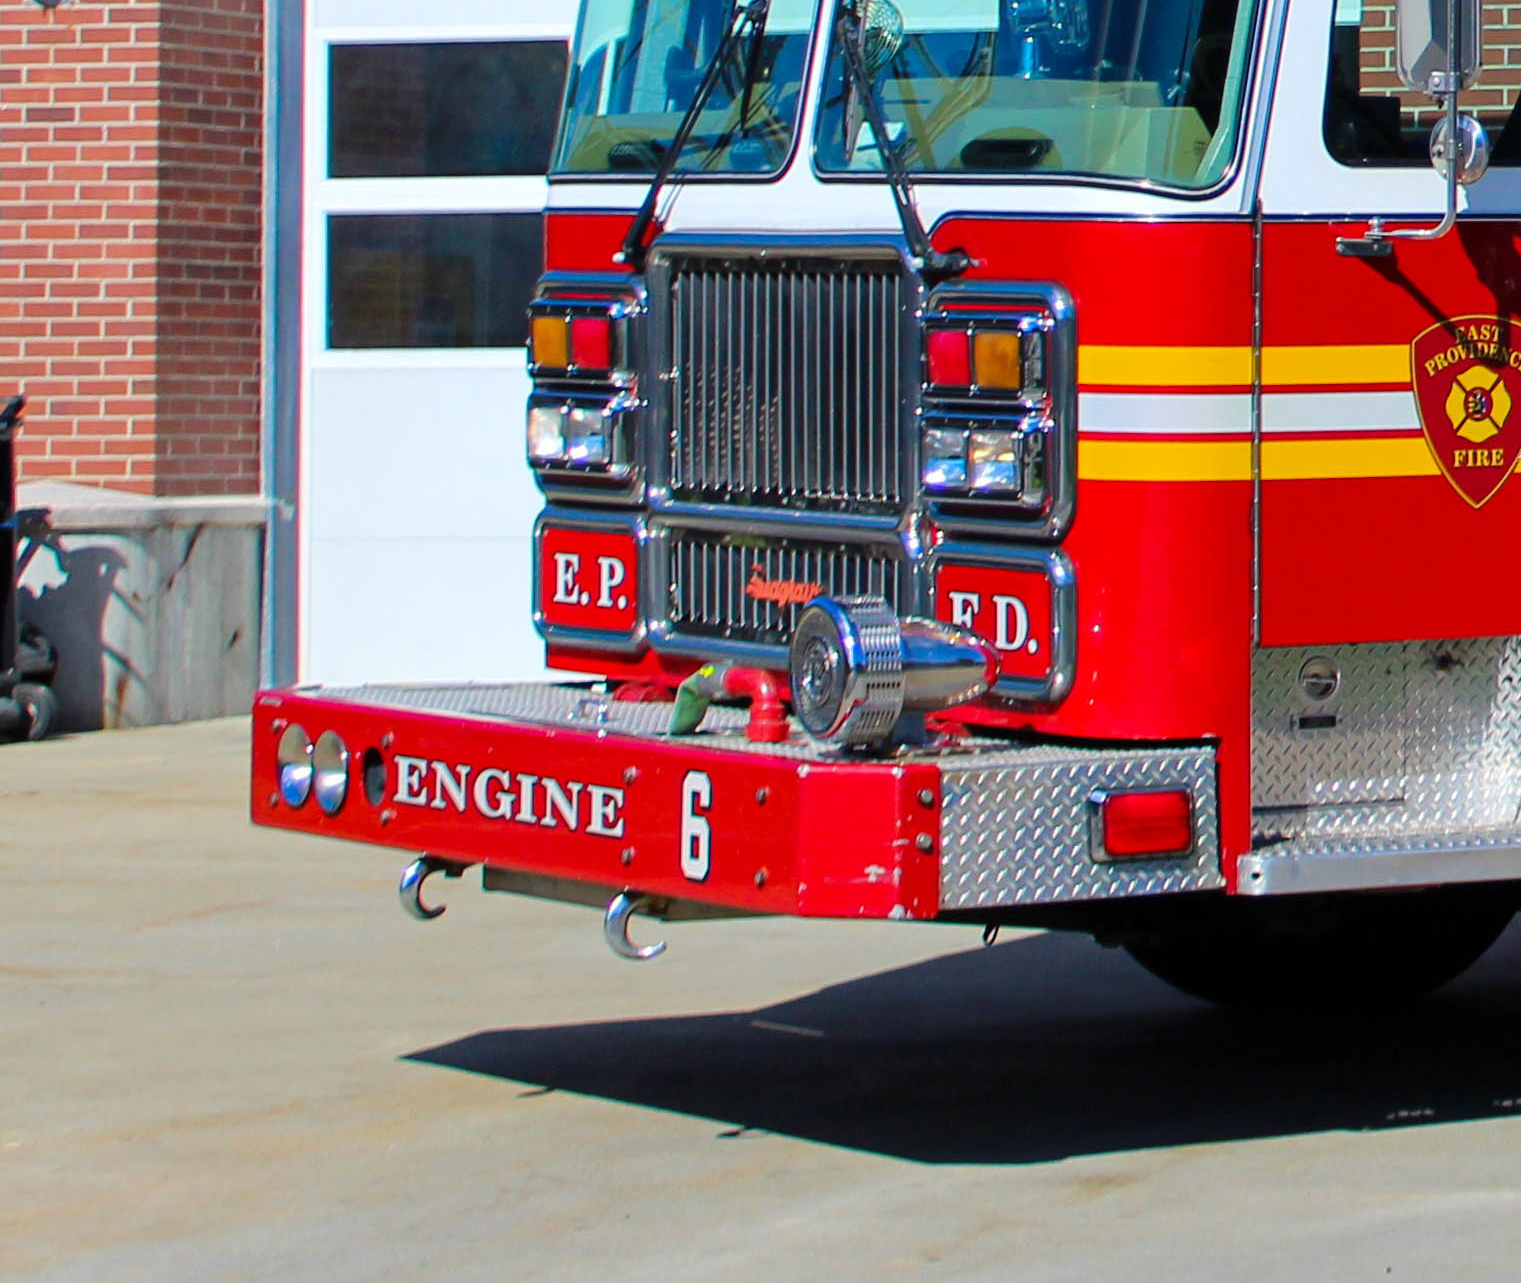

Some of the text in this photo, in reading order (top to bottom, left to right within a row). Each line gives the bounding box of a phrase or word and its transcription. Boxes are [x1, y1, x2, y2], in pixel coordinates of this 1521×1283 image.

[1455, 324, 1504, 344] EAST
[1453, 449, 1504, 468] FIRE
[393, 755, 712, 882] ENGINE 6
